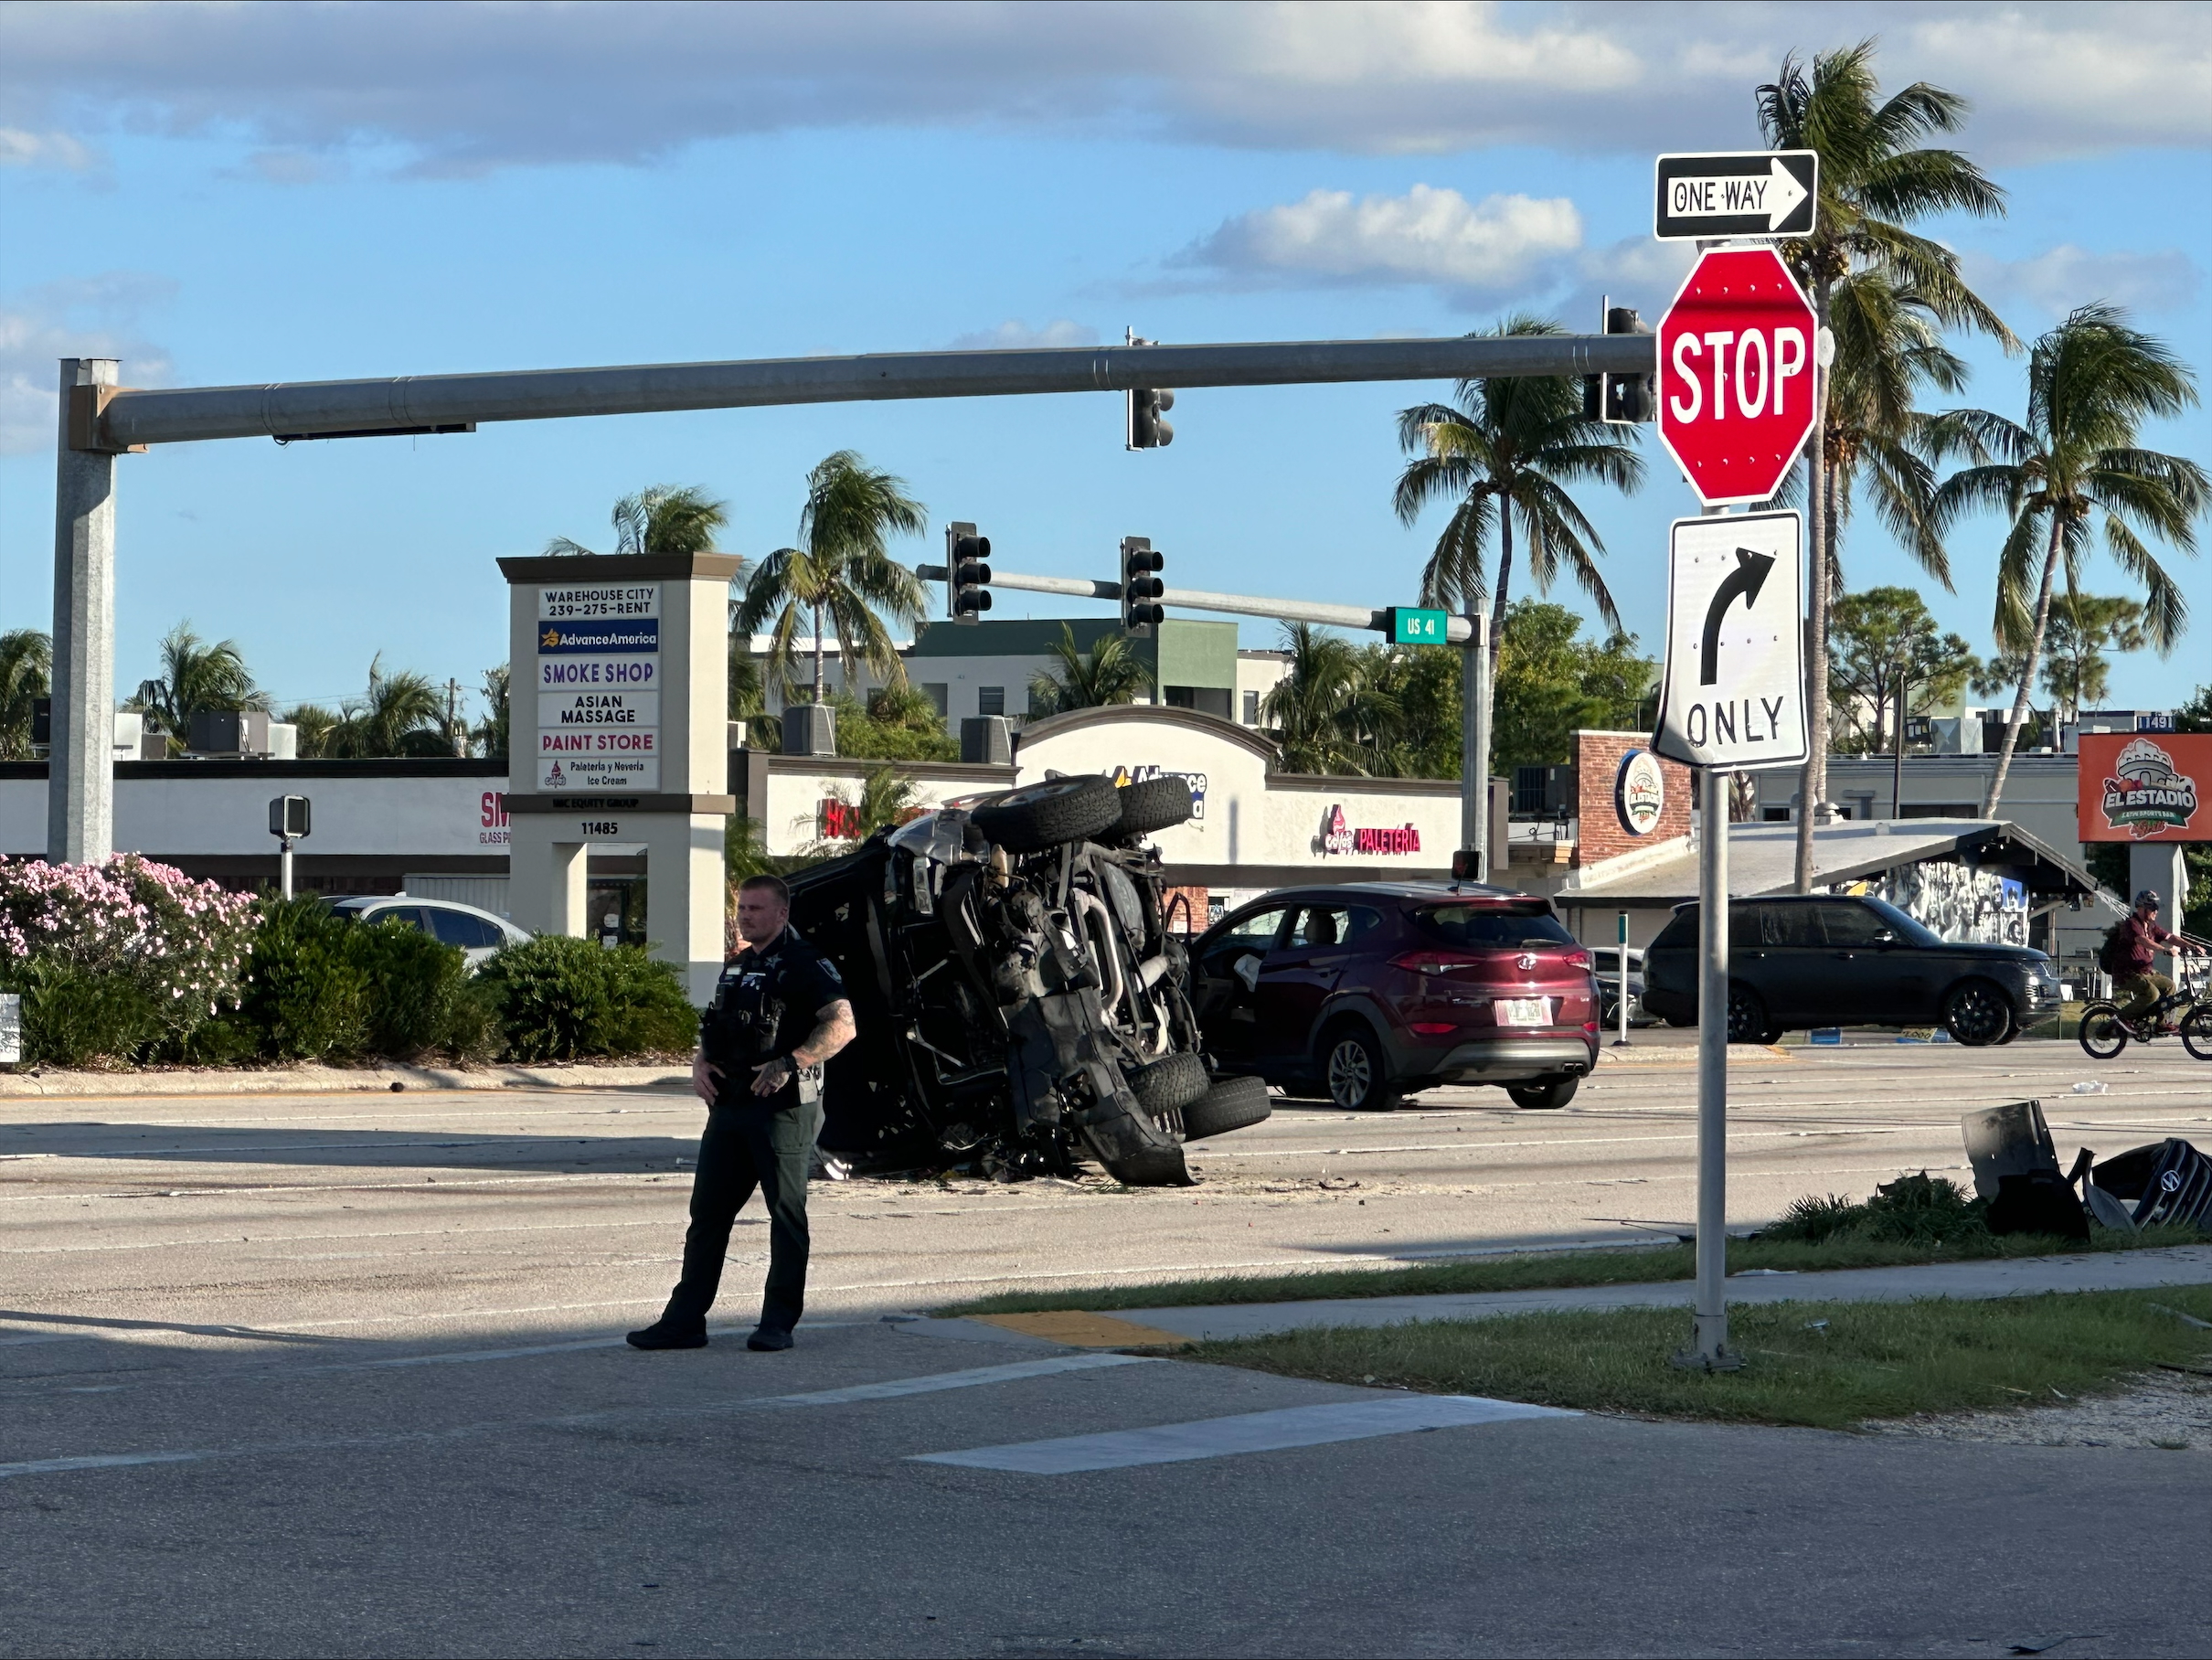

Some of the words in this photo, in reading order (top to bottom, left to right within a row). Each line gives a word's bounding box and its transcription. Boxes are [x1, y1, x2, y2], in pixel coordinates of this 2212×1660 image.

[1675, 181, 1716, 212] ONE
[1725, 180, 1768, 210] WAY
[1670, 326, 1806, 424] STOP
[545, 590, 623, 603] WAREHOUSE
[626, 588, 654, 601] CITY
[548, 601, 651, 617] 239-275-RENT
[1407, 617, 1420, 635] US
[1424, 618, 1435, 635] 41
[543, 664, 600, 684] SMOKE
[604, 663, 654, 683] SHOP
[574, 696, 622, 708] ASIAN
[560, 709, 636, 724] MASSAGE
[1687, 696, 1783, 748] ONLY
[2139, 716, 2173, 729] 11491
[542, 735, 592, 751] PAINT
[597, 734, 654, 750] STORE
[608, 763, 613, 773] y
[587, 775, 600, 785] Ice
[571, 798, 605, 809] EQUITY
[606, 798, 639, 808] GROUP
[2105, 792, 2124, 808] EL
[2125, 789, 2195, 808] ESTADIO
[581, 822, 618, 835] 11485
